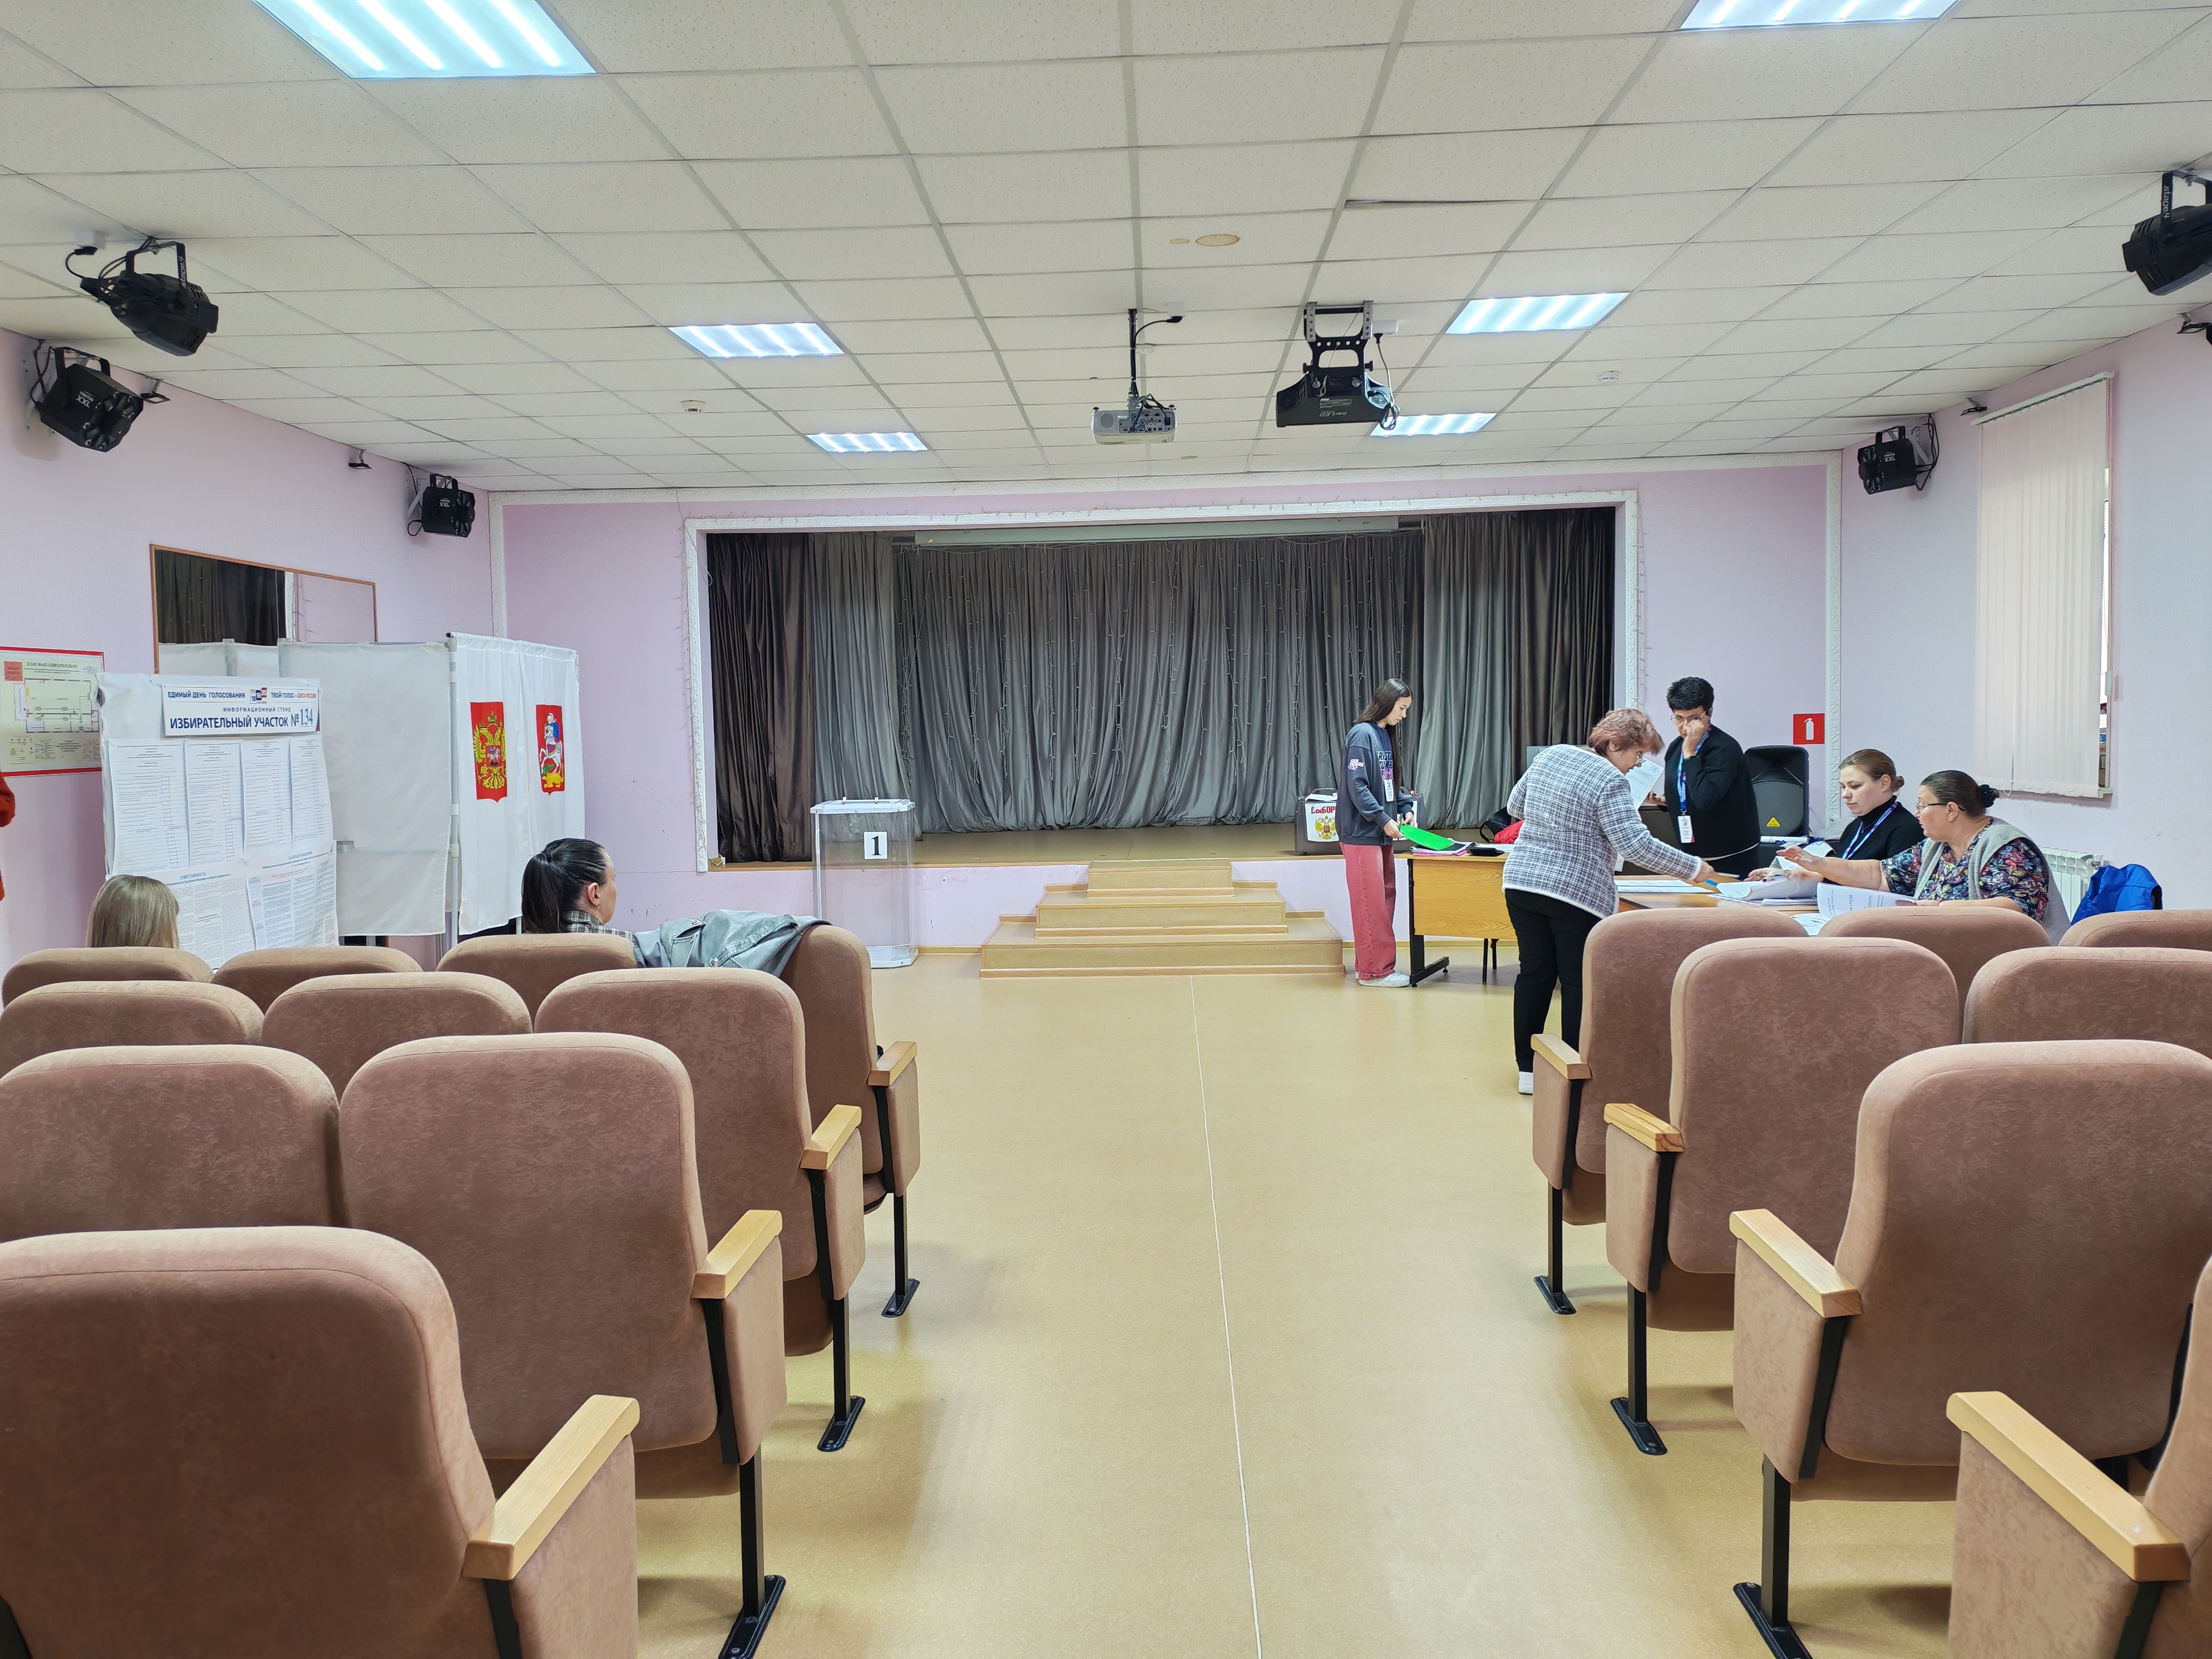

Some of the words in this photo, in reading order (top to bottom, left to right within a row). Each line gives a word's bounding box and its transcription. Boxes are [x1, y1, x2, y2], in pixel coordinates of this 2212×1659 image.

[76, 395, 90, 408] XXL
[168, 690, 191, 699] ЕДИНЫЙ
[170, 715, 252, 729] ИЗБИРАТЕЛЬНЫЙ
[254, 717, 288, 727] УЧАСТОК
[871, 835, 882, 856] 1
